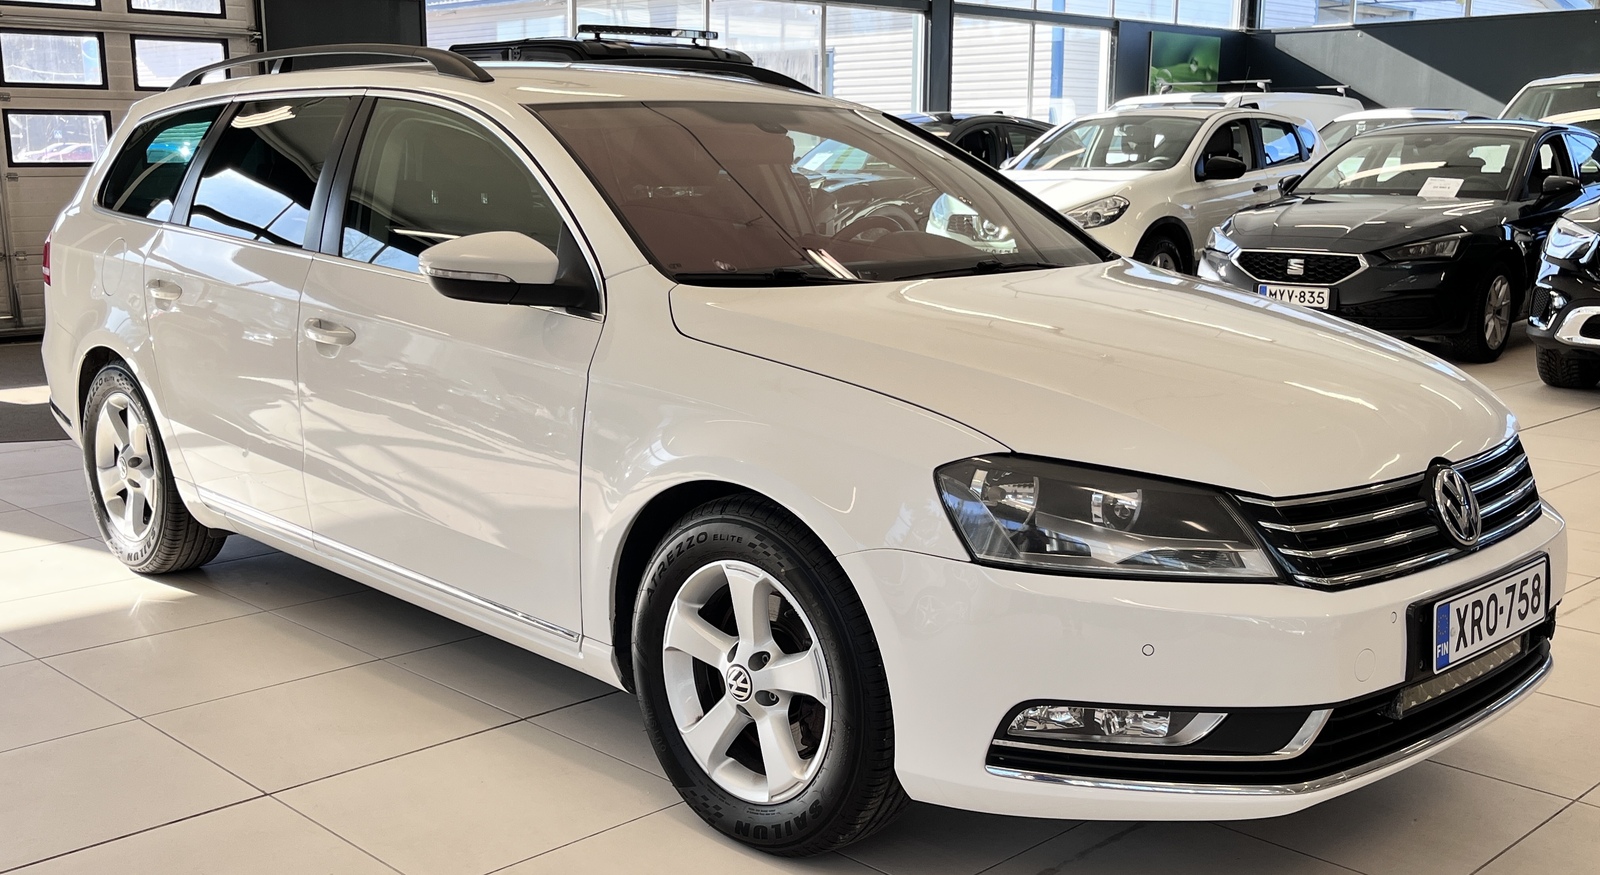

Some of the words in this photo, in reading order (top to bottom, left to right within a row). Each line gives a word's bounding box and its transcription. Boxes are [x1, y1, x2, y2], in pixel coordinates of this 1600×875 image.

[1268, 289, 1325, 304] MYV-835
[646, 531, 708, 604] ATREZZO
[712, 533, 743, 544] ELITE
[1455, 573, 1541, 652] XRO-758
[1436, 641, 1449, 658] FIN
[735, 799, 824, 839] SAILUN
